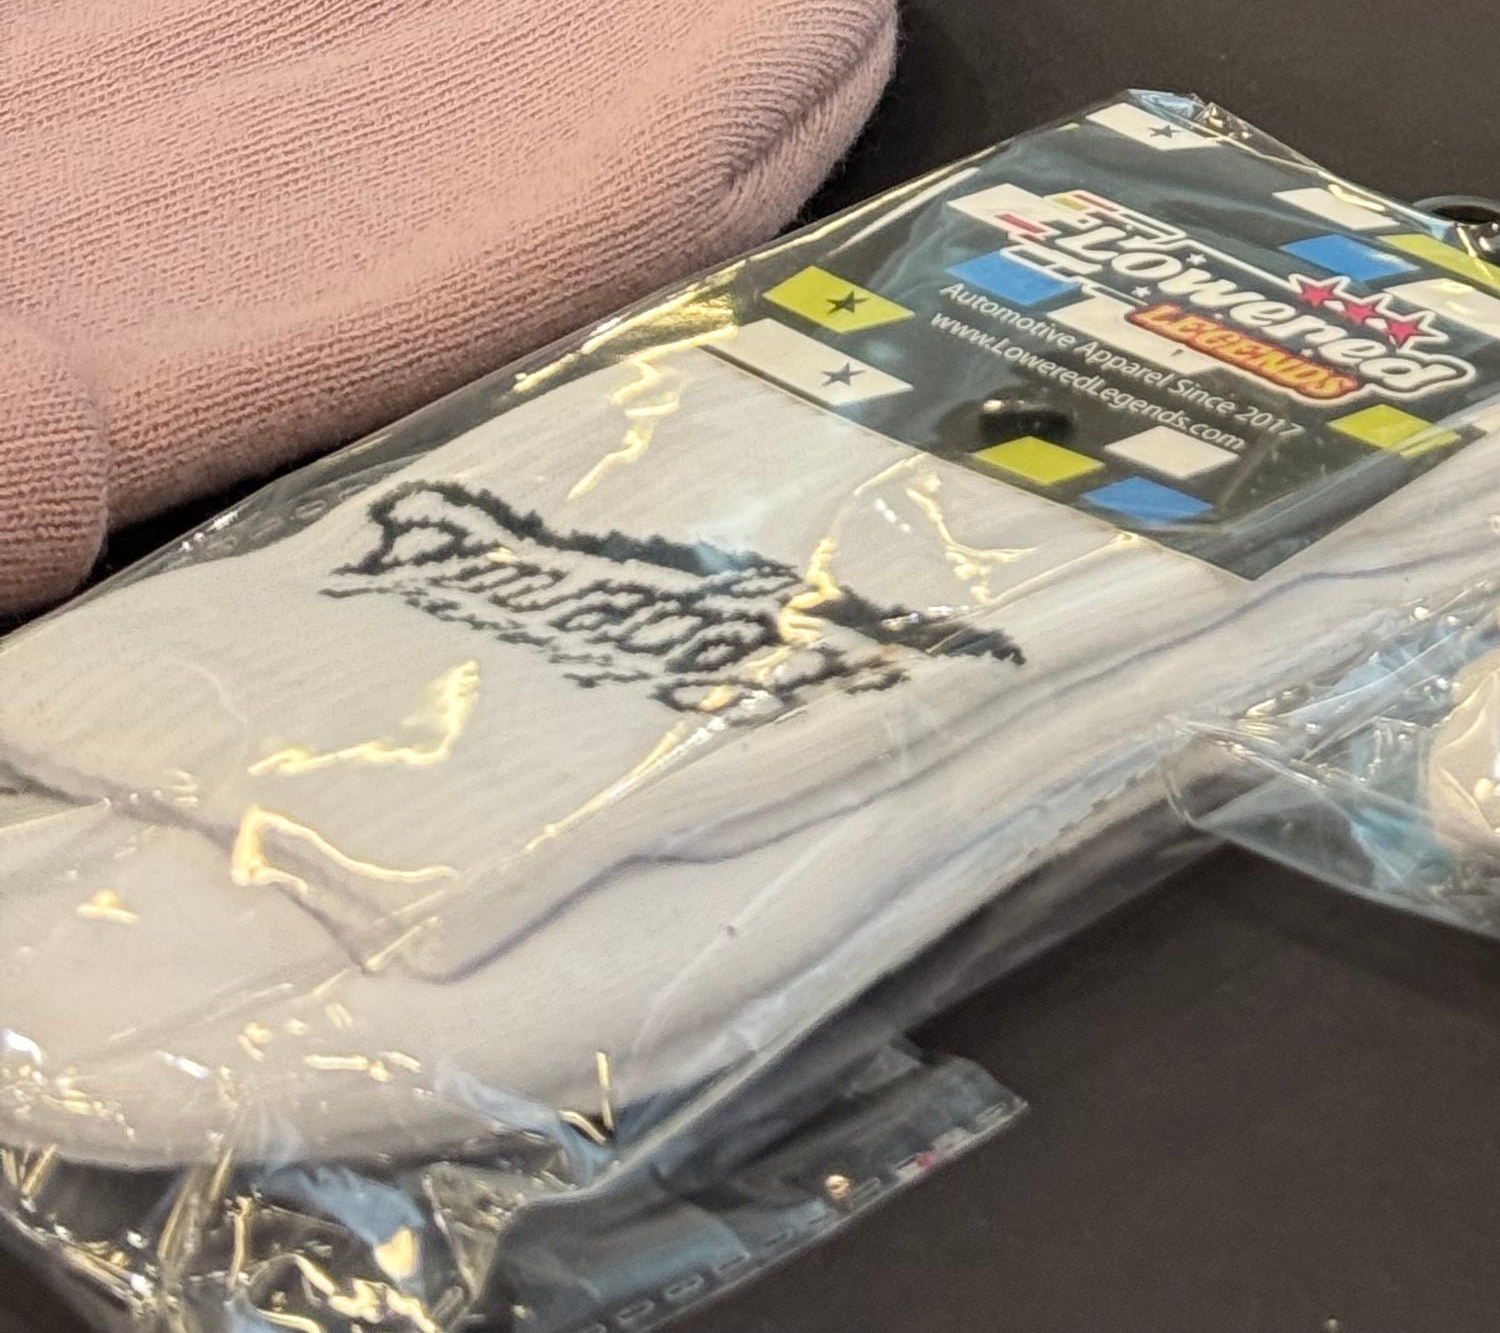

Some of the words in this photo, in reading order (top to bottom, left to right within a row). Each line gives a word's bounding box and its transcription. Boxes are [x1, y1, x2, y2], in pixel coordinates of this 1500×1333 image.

[939, 283, 1076, 348] Automotive
[1081, 341, 1175, 388] Apparel
[1167, 378, 1236, 417] Since
[1233, 404, 1305, 438] 2017
[1054, 226, 1458, 390] Lowered
[1134, 303, 1361, 399] LEGENDS
[931, 312, 1246, 452] www.LoweredLegends.com
